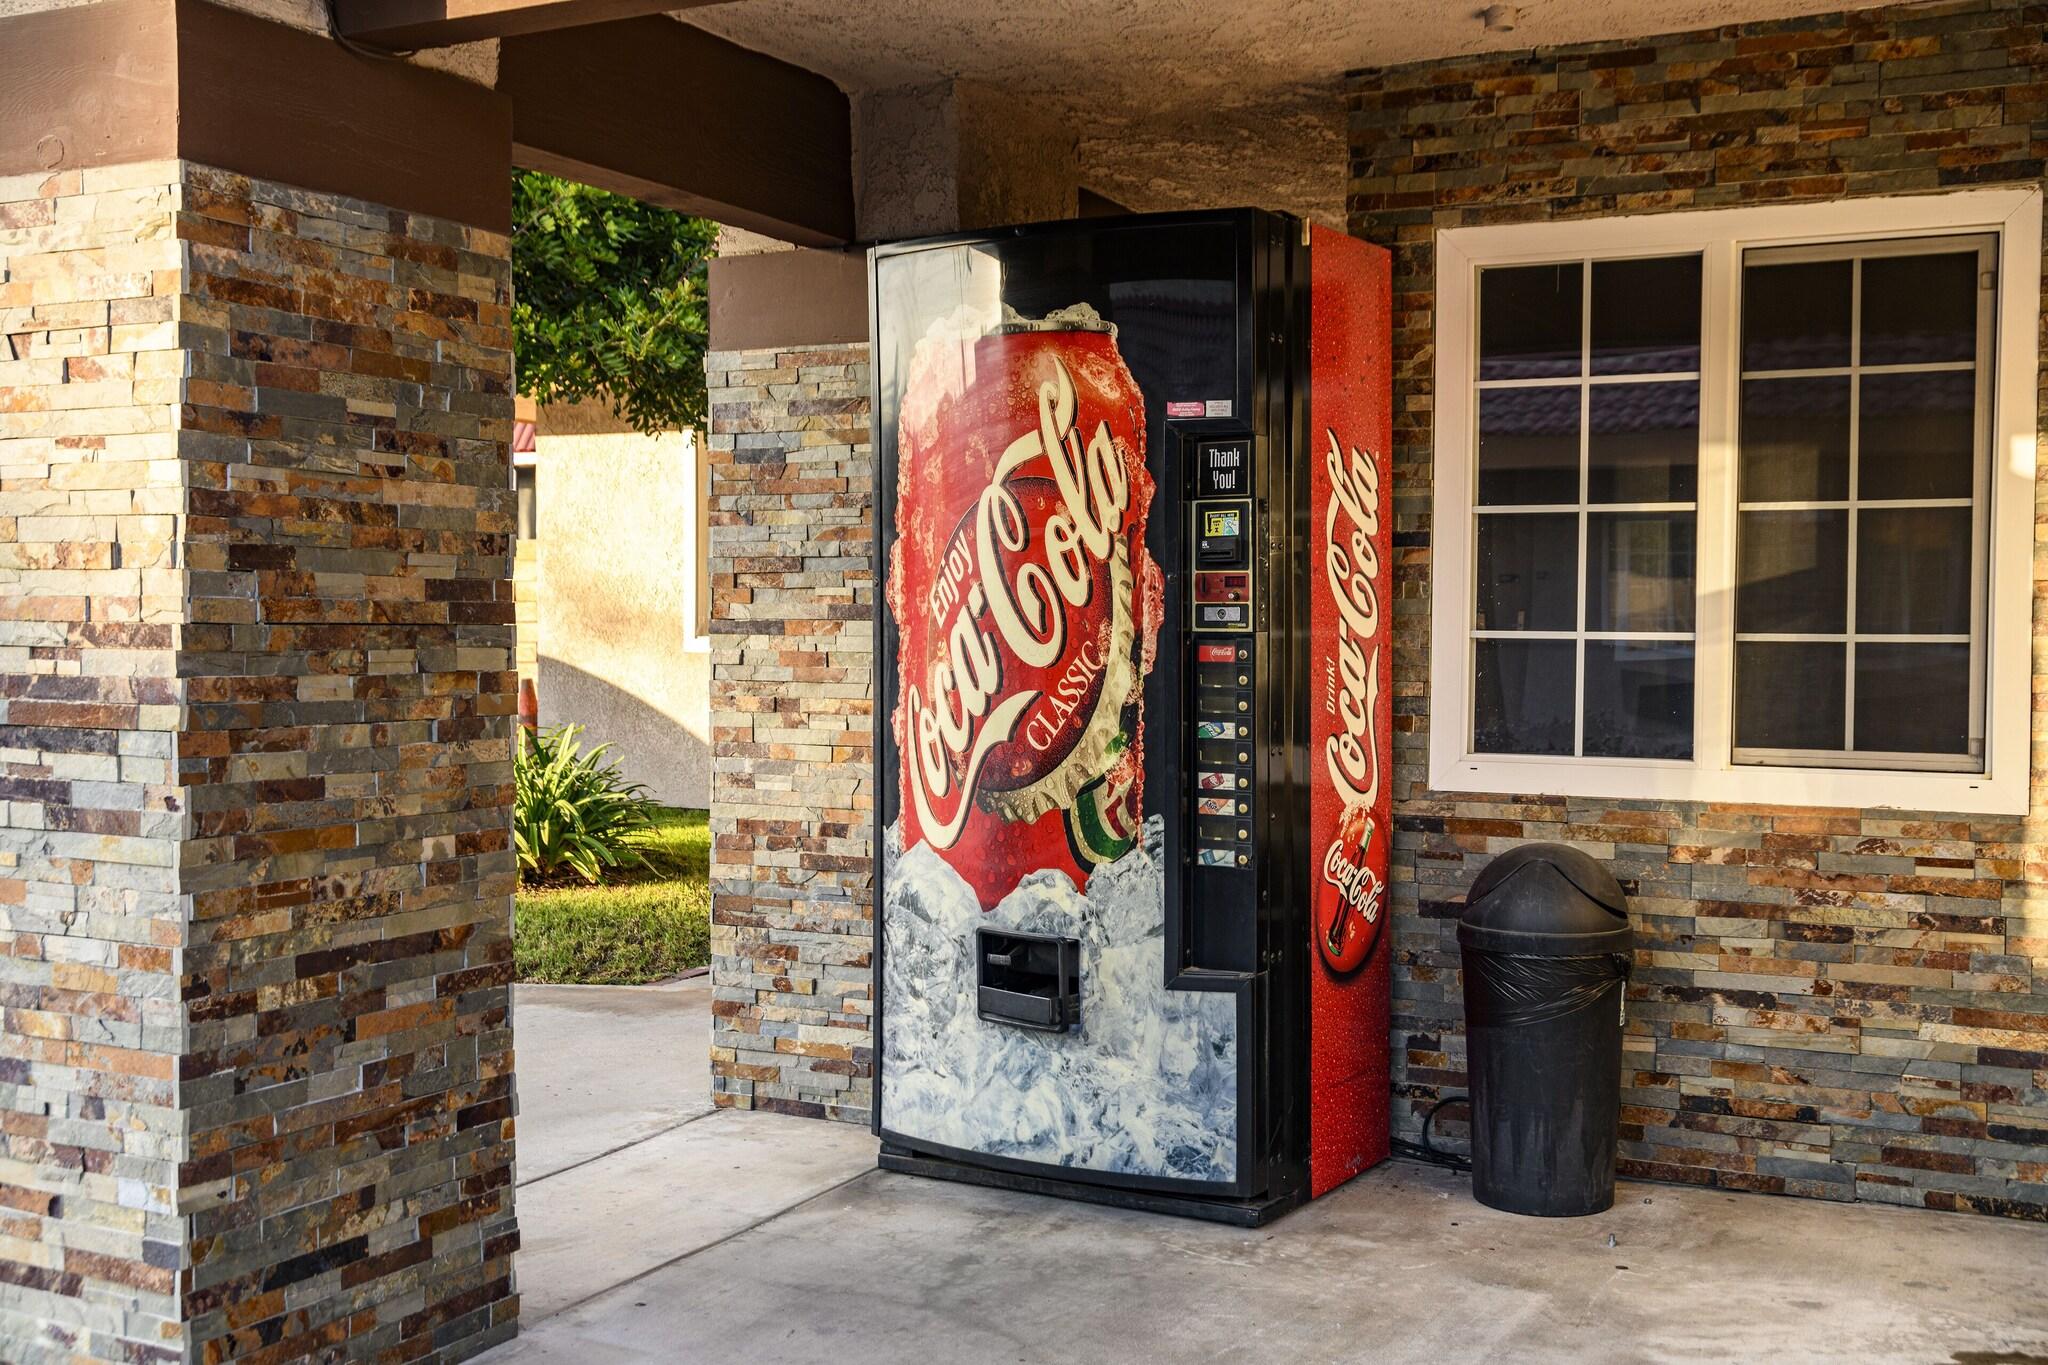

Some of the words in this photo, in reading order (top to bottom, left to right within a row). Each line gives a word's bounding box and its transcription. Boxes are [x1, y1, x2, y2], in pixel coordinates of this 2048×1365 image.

[1209, 448, 1240, 468] Thank
[1212, 470, 1236, 490] You!
[908, 353, 1128, 849] Coca-Cola
[929, 529, 973, 629] Enjoy
[1326, 427, 1378, 812] Coca-Cola
[1027, 640, 1104, 751] CLASSIC
[1326, 656, 1336, 715] Drink!
[1323, 839, 1385, 924] Coca-Cola
